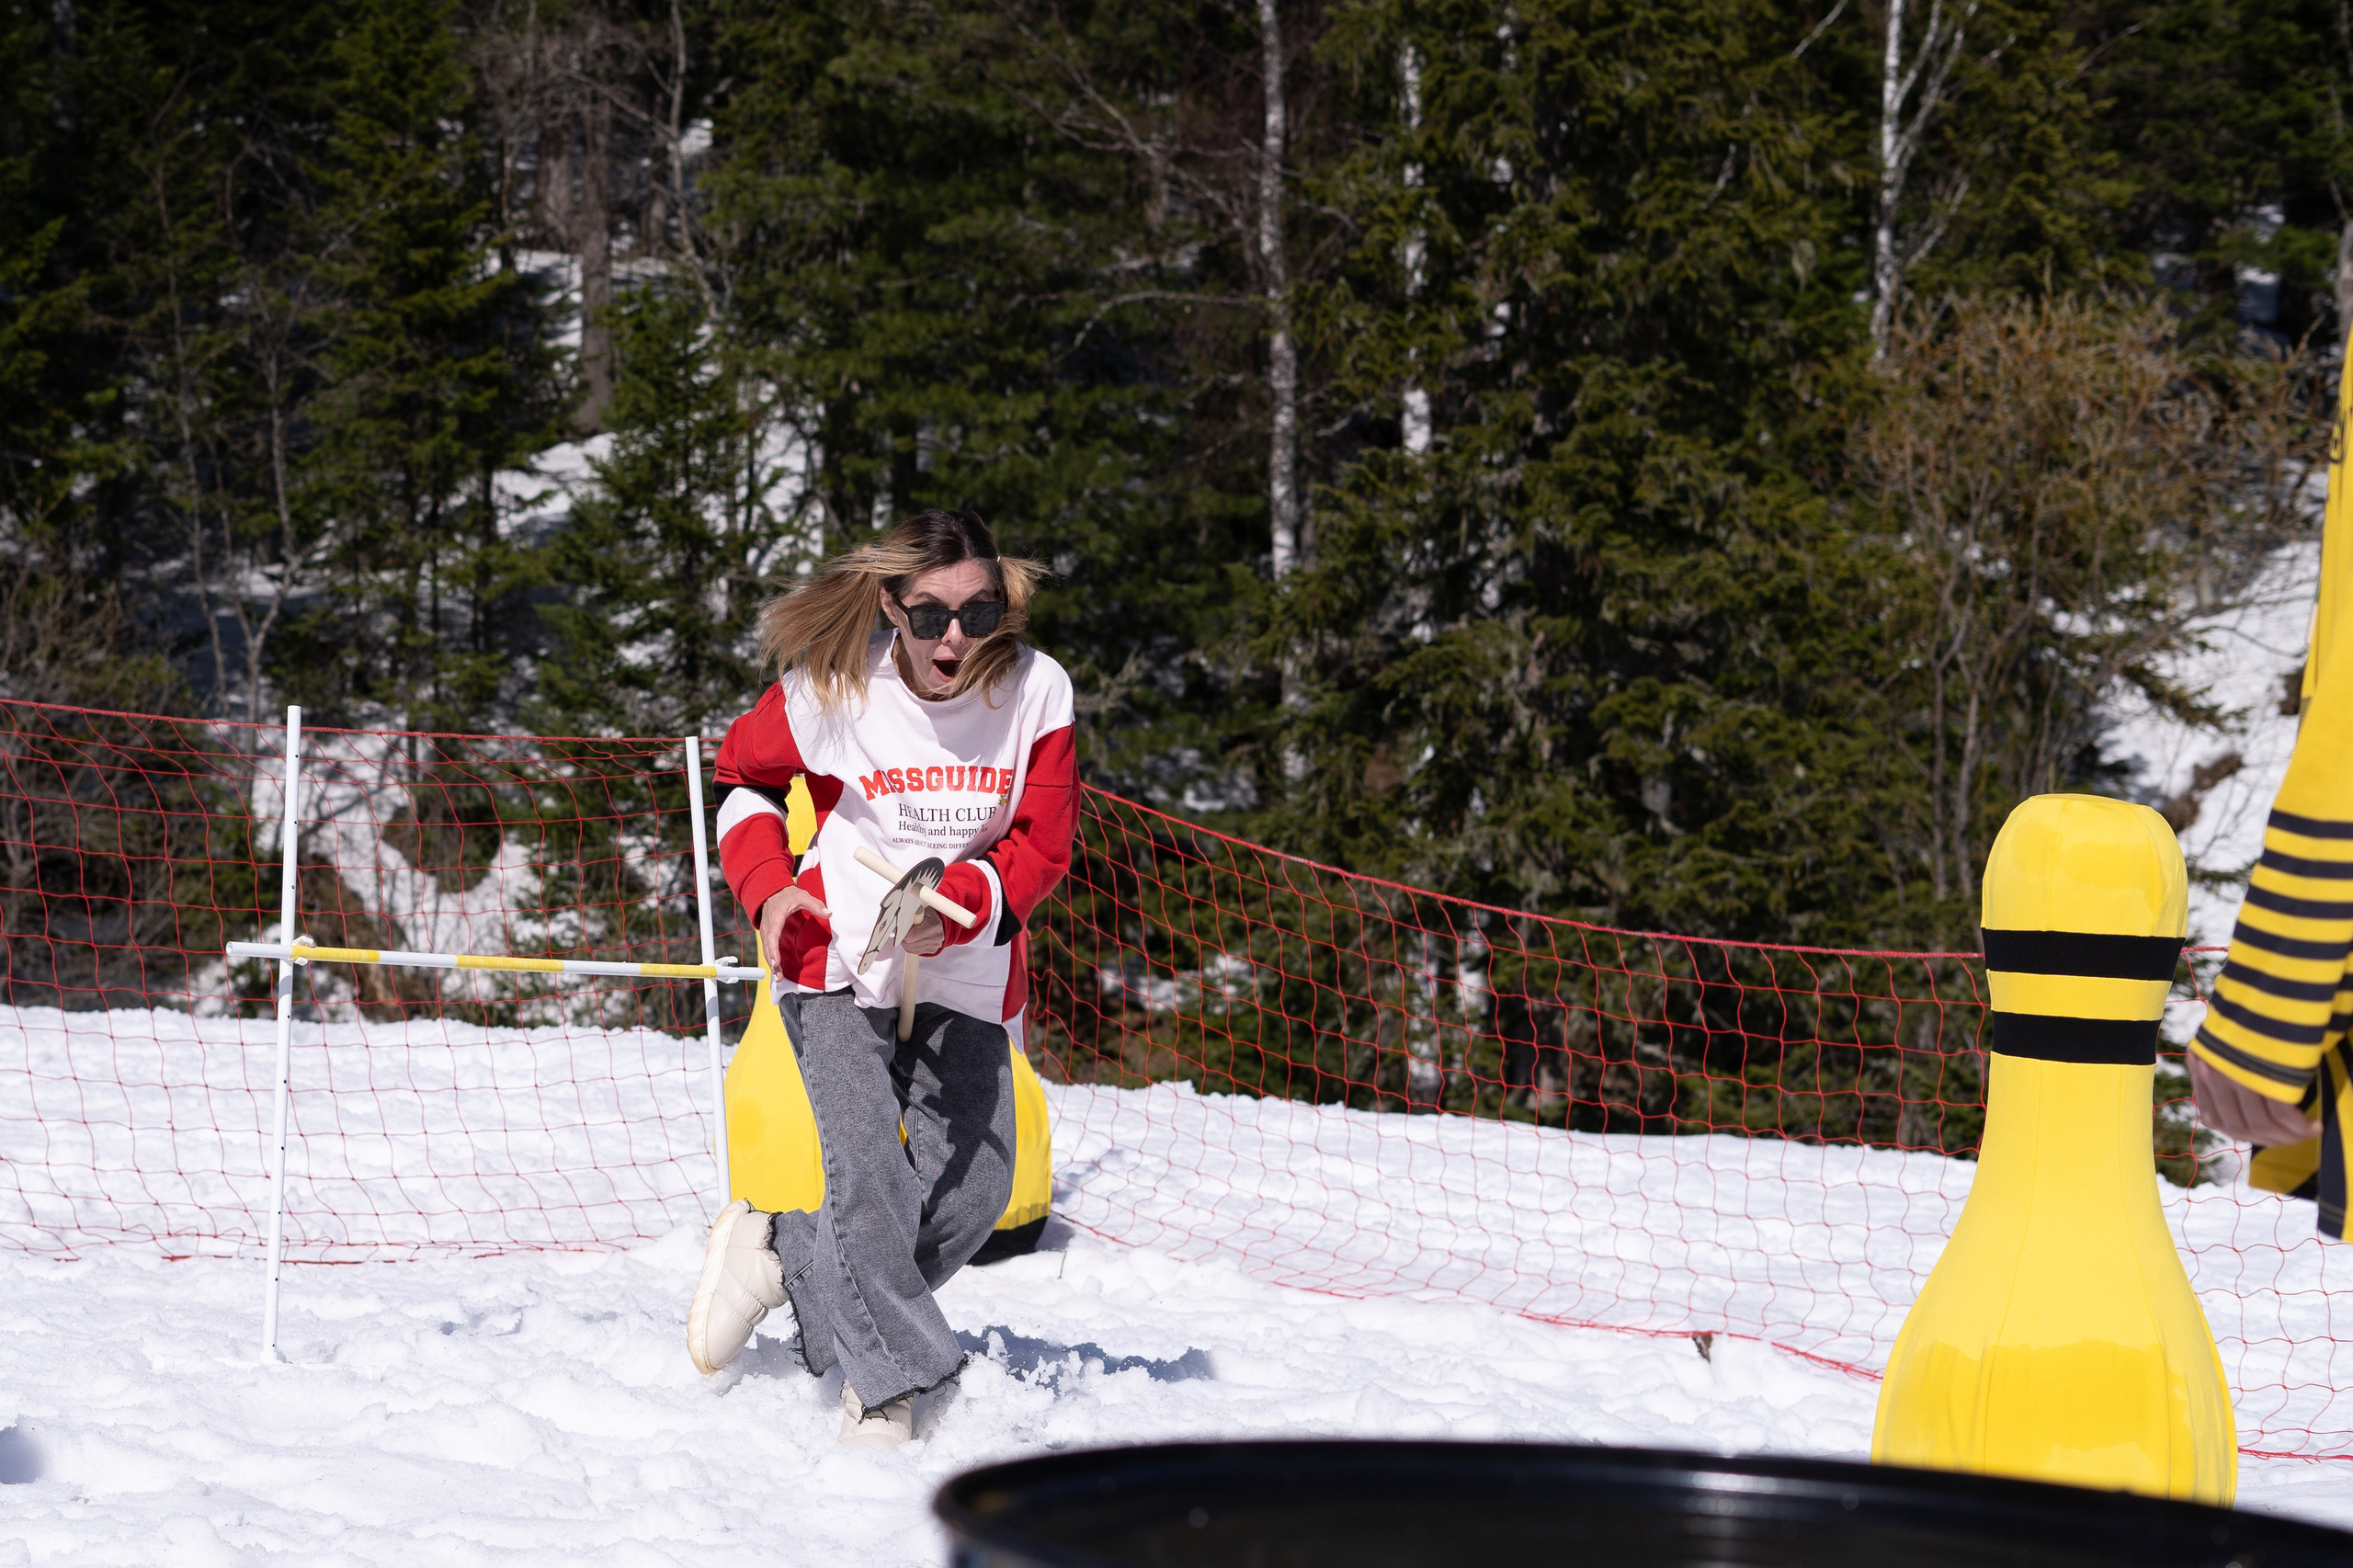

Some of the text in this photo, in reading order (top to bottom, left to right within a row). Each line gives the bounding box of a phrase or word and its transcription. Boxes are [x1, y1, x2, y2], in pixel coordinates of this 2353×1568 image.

[898, 803, 950, 822] HEALTH
[927, 826, 947, 836] and
[949, 826, 980, 838] happy
